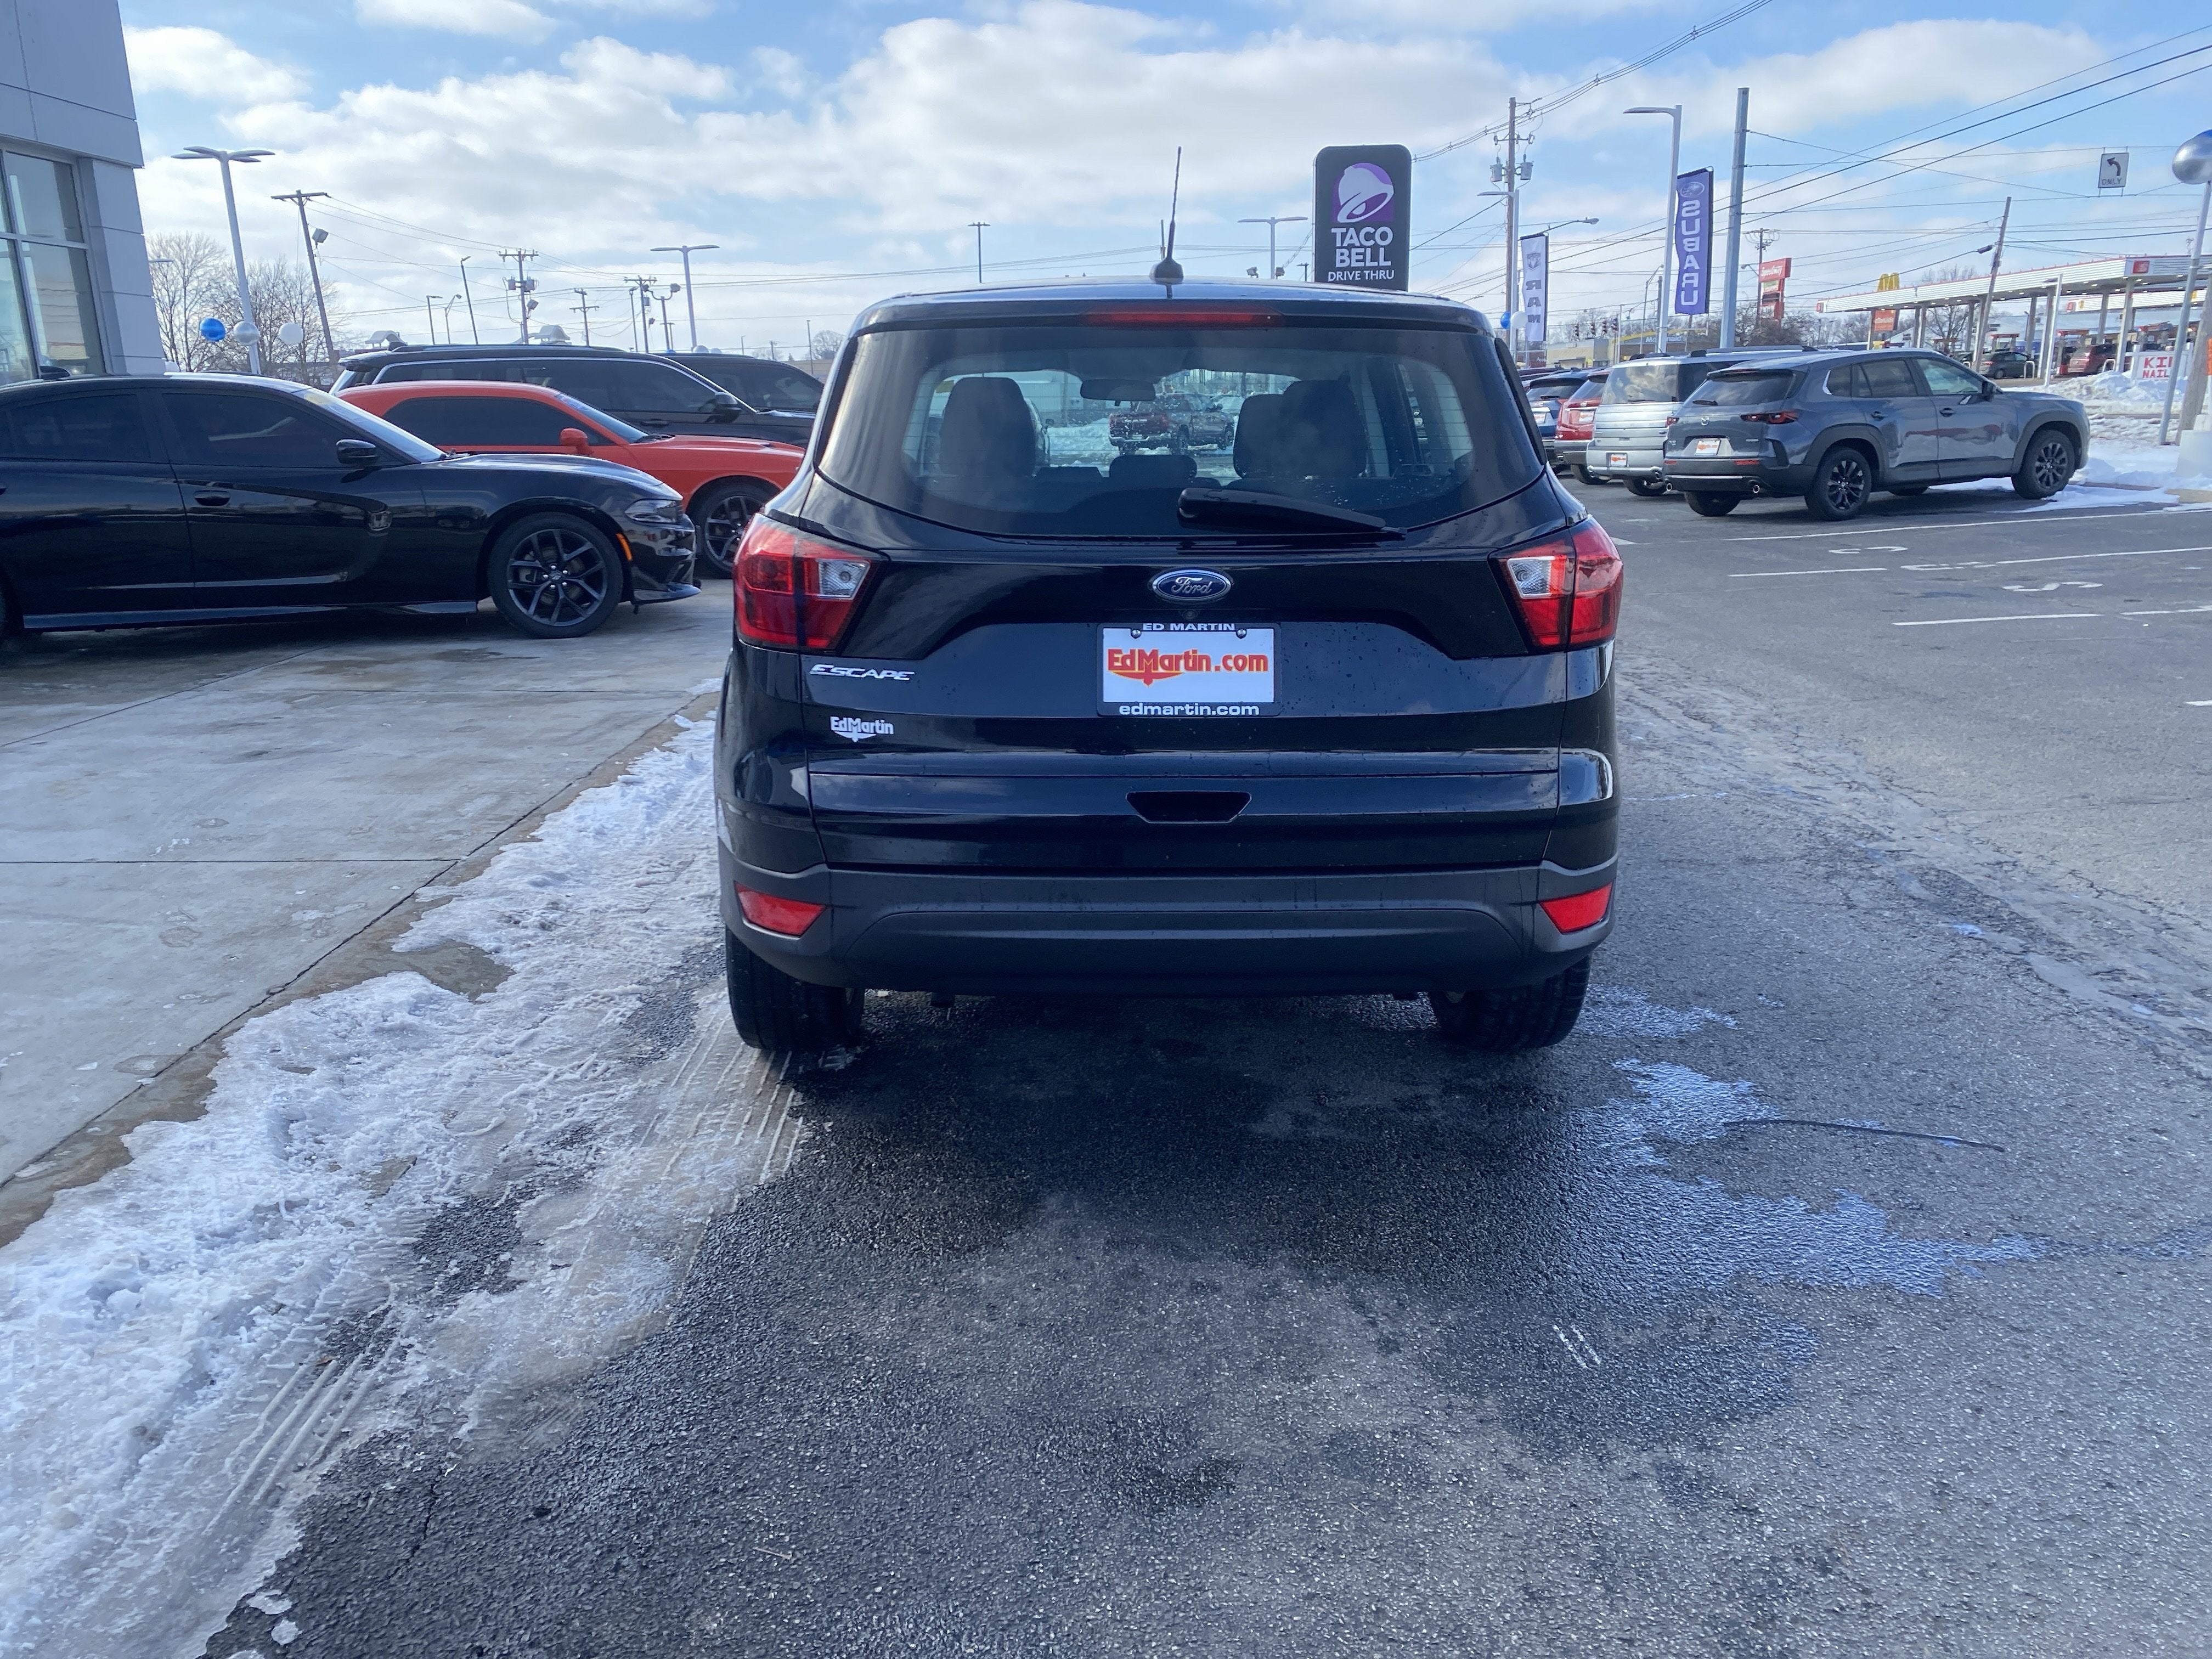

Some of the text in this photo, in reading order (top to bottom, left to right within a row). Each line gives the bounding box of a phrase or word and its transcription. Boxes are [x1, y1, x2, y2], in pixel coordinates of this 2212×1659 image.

[1331, 226, 1393, 247] TACO
[1335, 247, 1391, 268] BELL
[1328, 269, 1395, 282] DRIVE THRU
[1171, 576, 1214, 594] Ford
[1107, 648, 1269, 675] EdMartin.com
[809, 664, 915, 680] ESCAPE
[1119, 703, 1260, 715] edmartin.com
[830, 716, 894, 735] EdMartin
